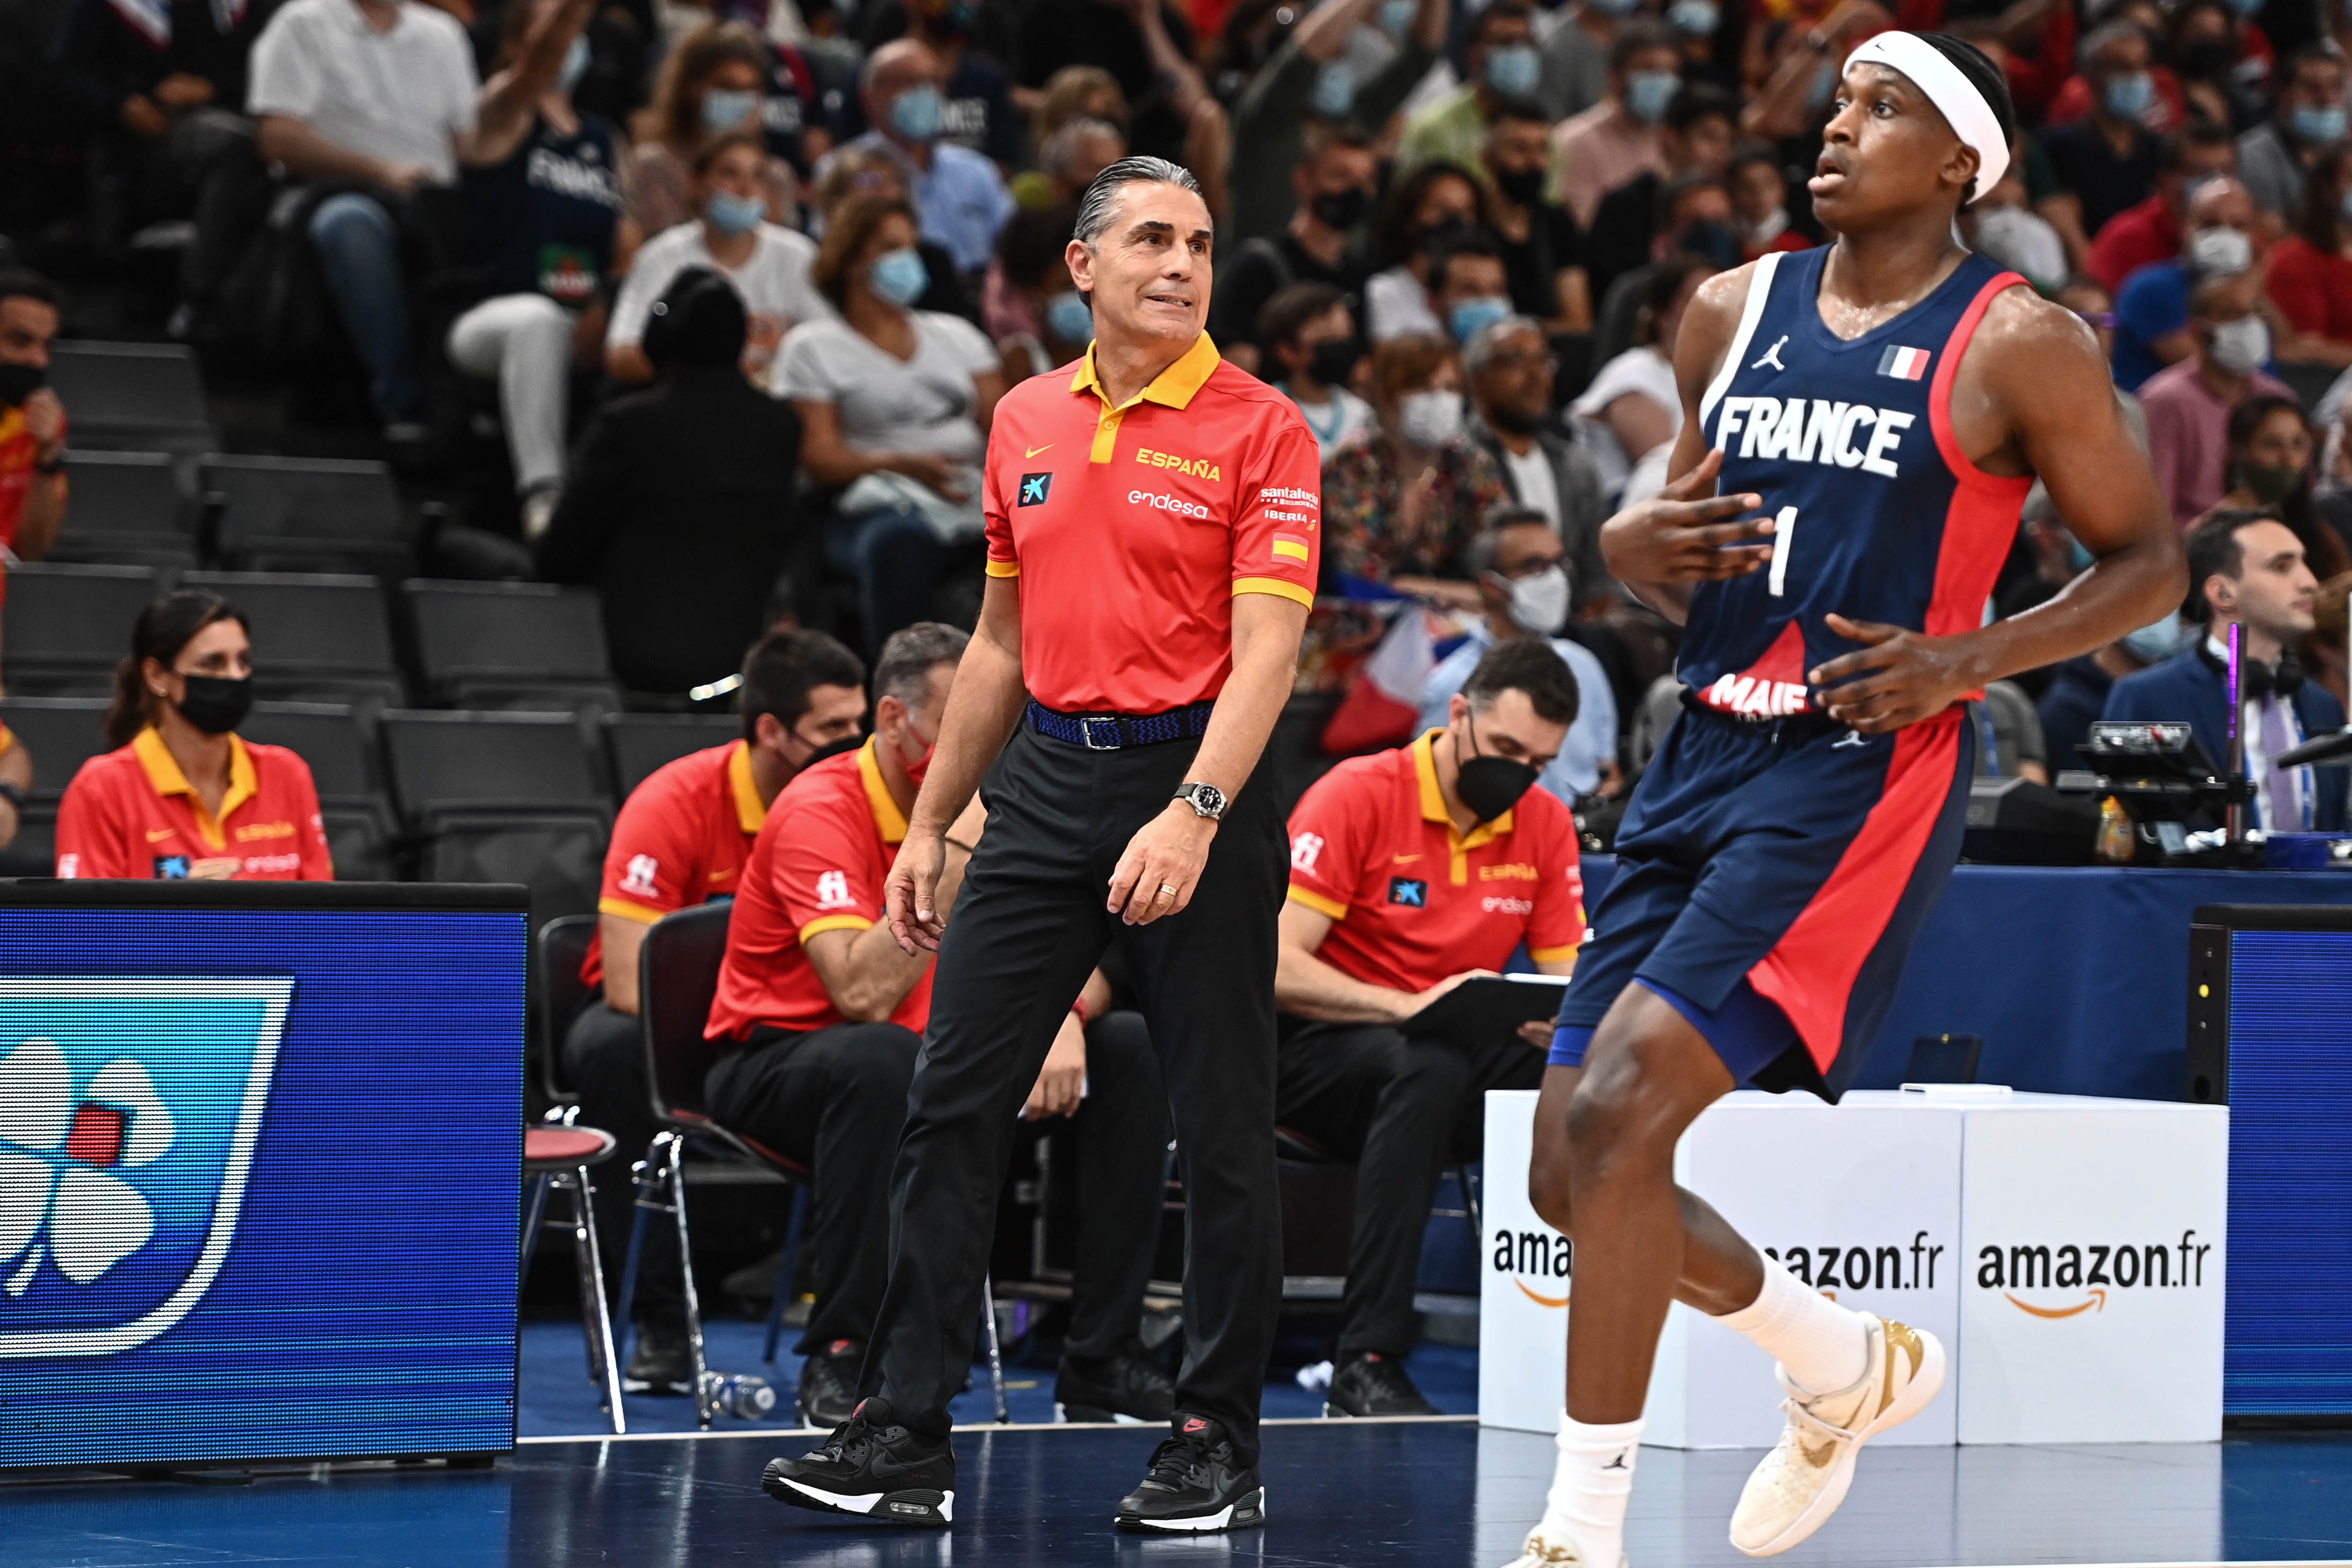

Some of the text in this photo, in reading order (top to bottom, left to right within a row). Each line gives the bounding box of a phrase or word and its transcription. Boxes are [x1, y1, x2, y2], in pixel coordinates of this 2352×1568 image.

[1715, 396, 1917, 479] FRANCE
[1135, 447, 1220, 482] ESPAÑA
[1128, 490, 1209, 519] endesa
[1264, 509, 1307, 523] IBERIA
[1768, 505, 1798, 597] 1
[1709, 673, 1808, 715] MAIF
[1764, 1230, 1944, 1290] azon.fr
[1977, 1229, 2211, 1288] amazon.fr
